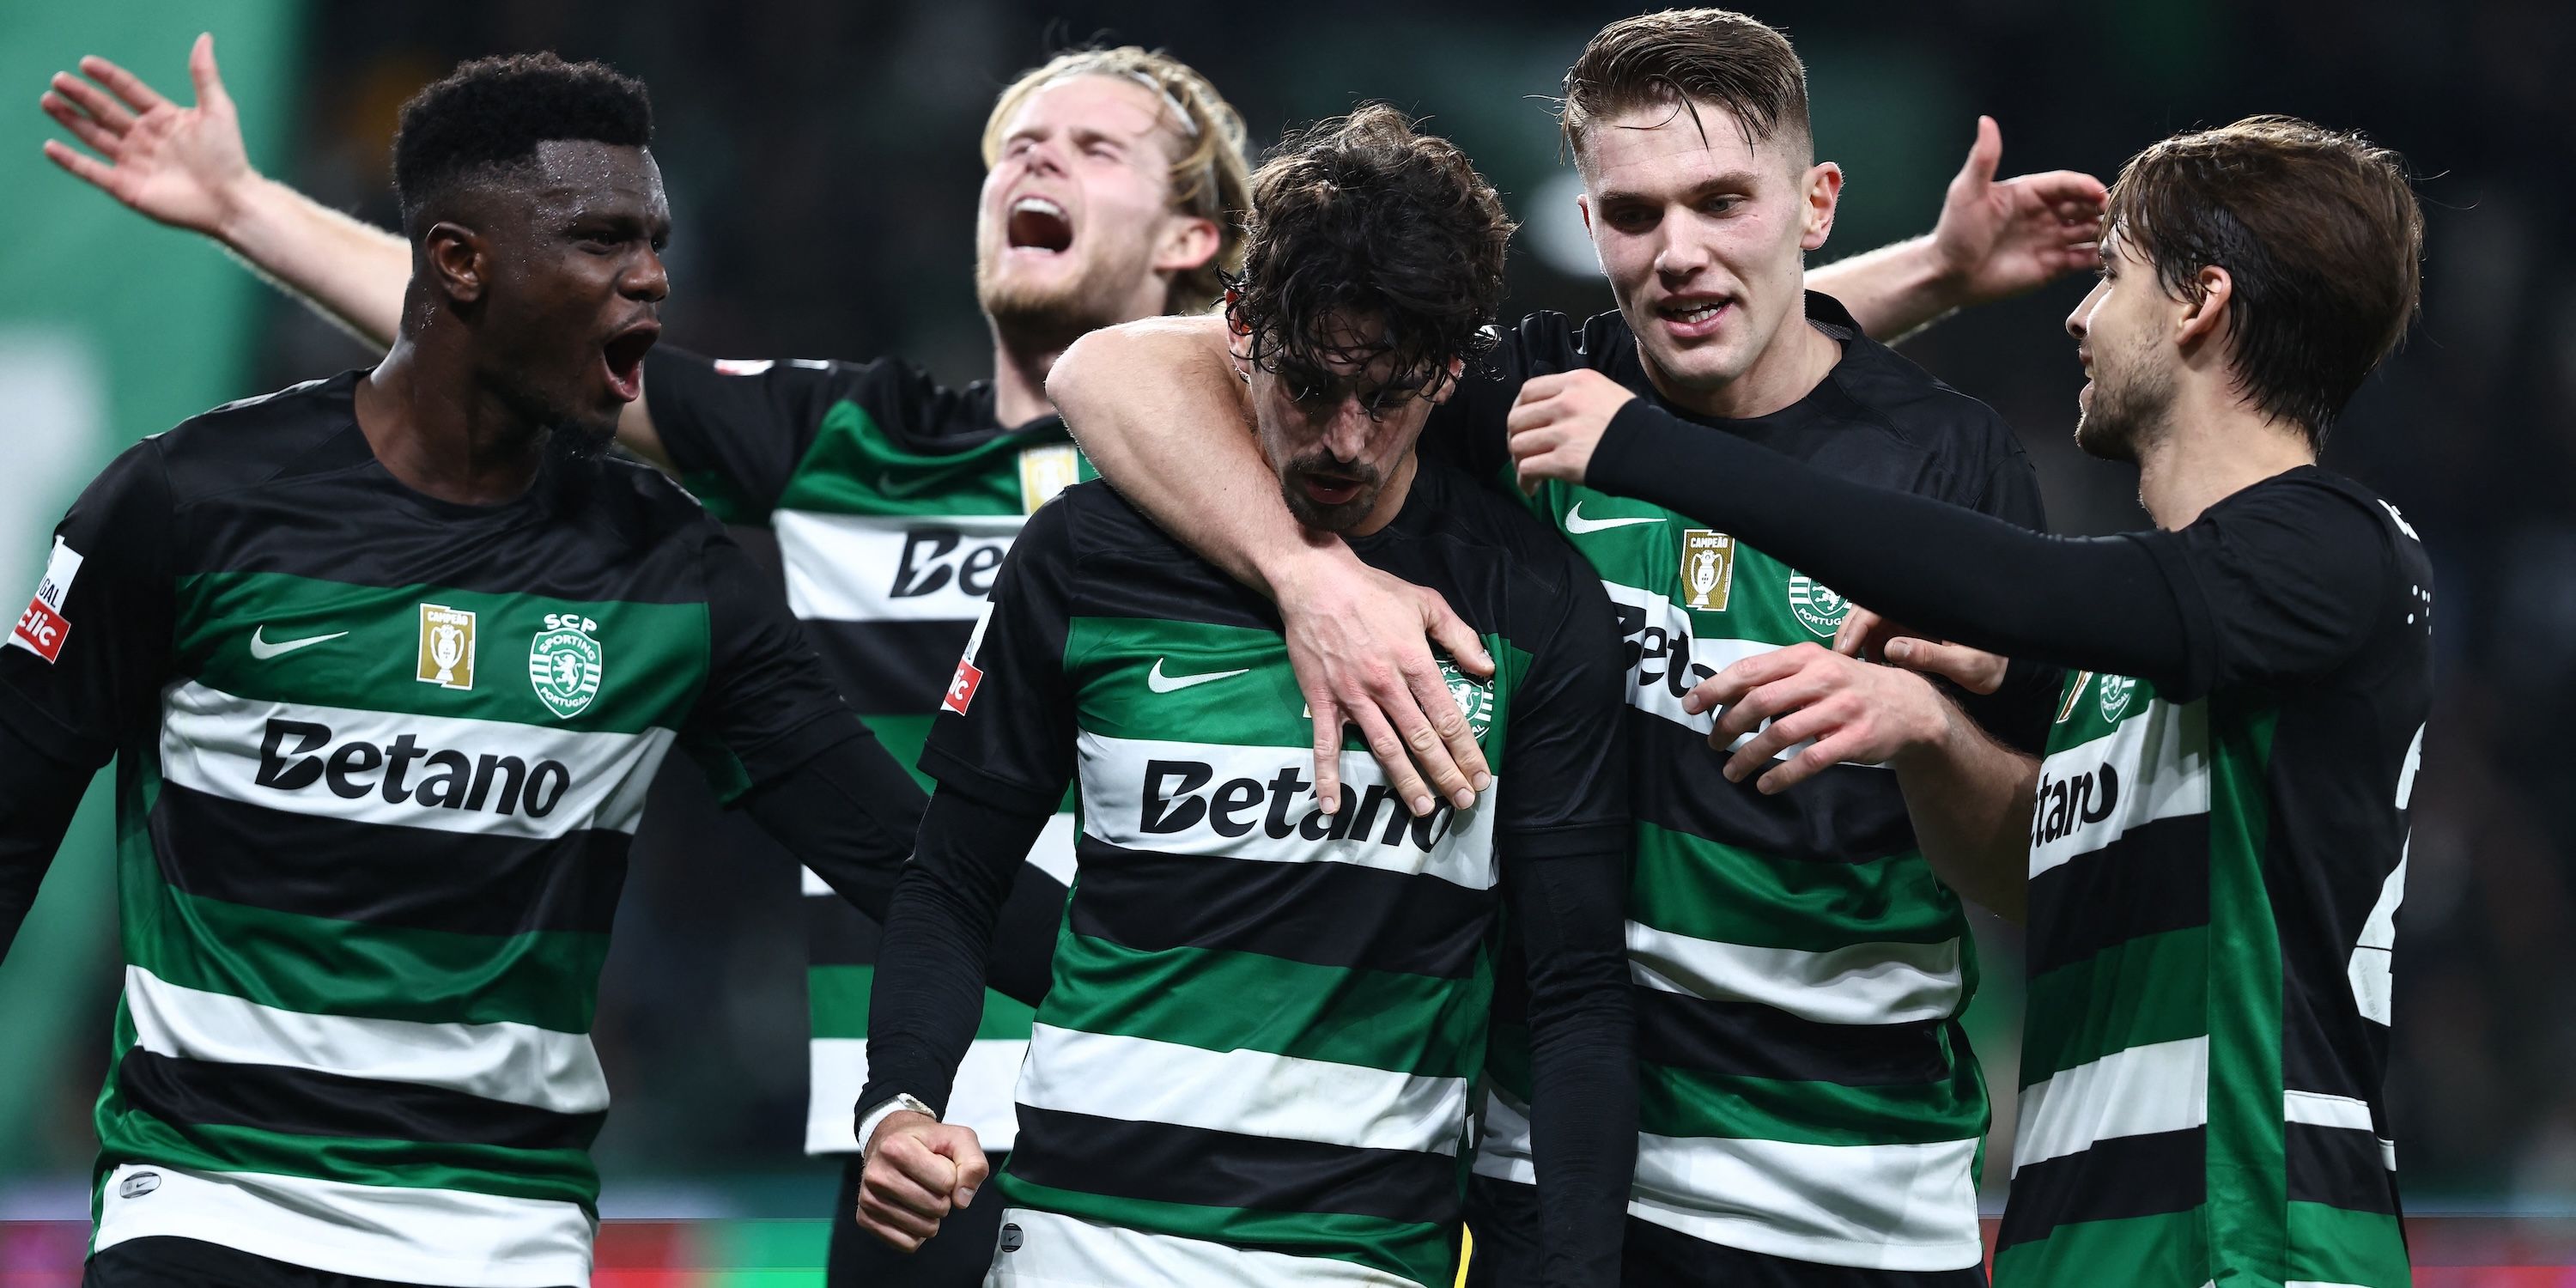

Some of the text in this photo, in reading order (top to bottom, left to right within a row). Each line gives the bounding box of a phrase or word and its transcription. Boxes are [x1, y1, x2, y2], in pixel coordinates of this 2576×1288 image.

[1690, 537, 1728, 549] CAMPEÃO
[544, 613, 598, 633] SCP
[1797, 607, 1844, 627] PORTUG
[538, 634, 597, 662] SPORTING
[540, 686, 590, 708] PORTUGAL
[255, 718, 570, 818] Betano
[1139, 759, 1455, 853] Betano
[2031, 761, 2119, 848] tano
